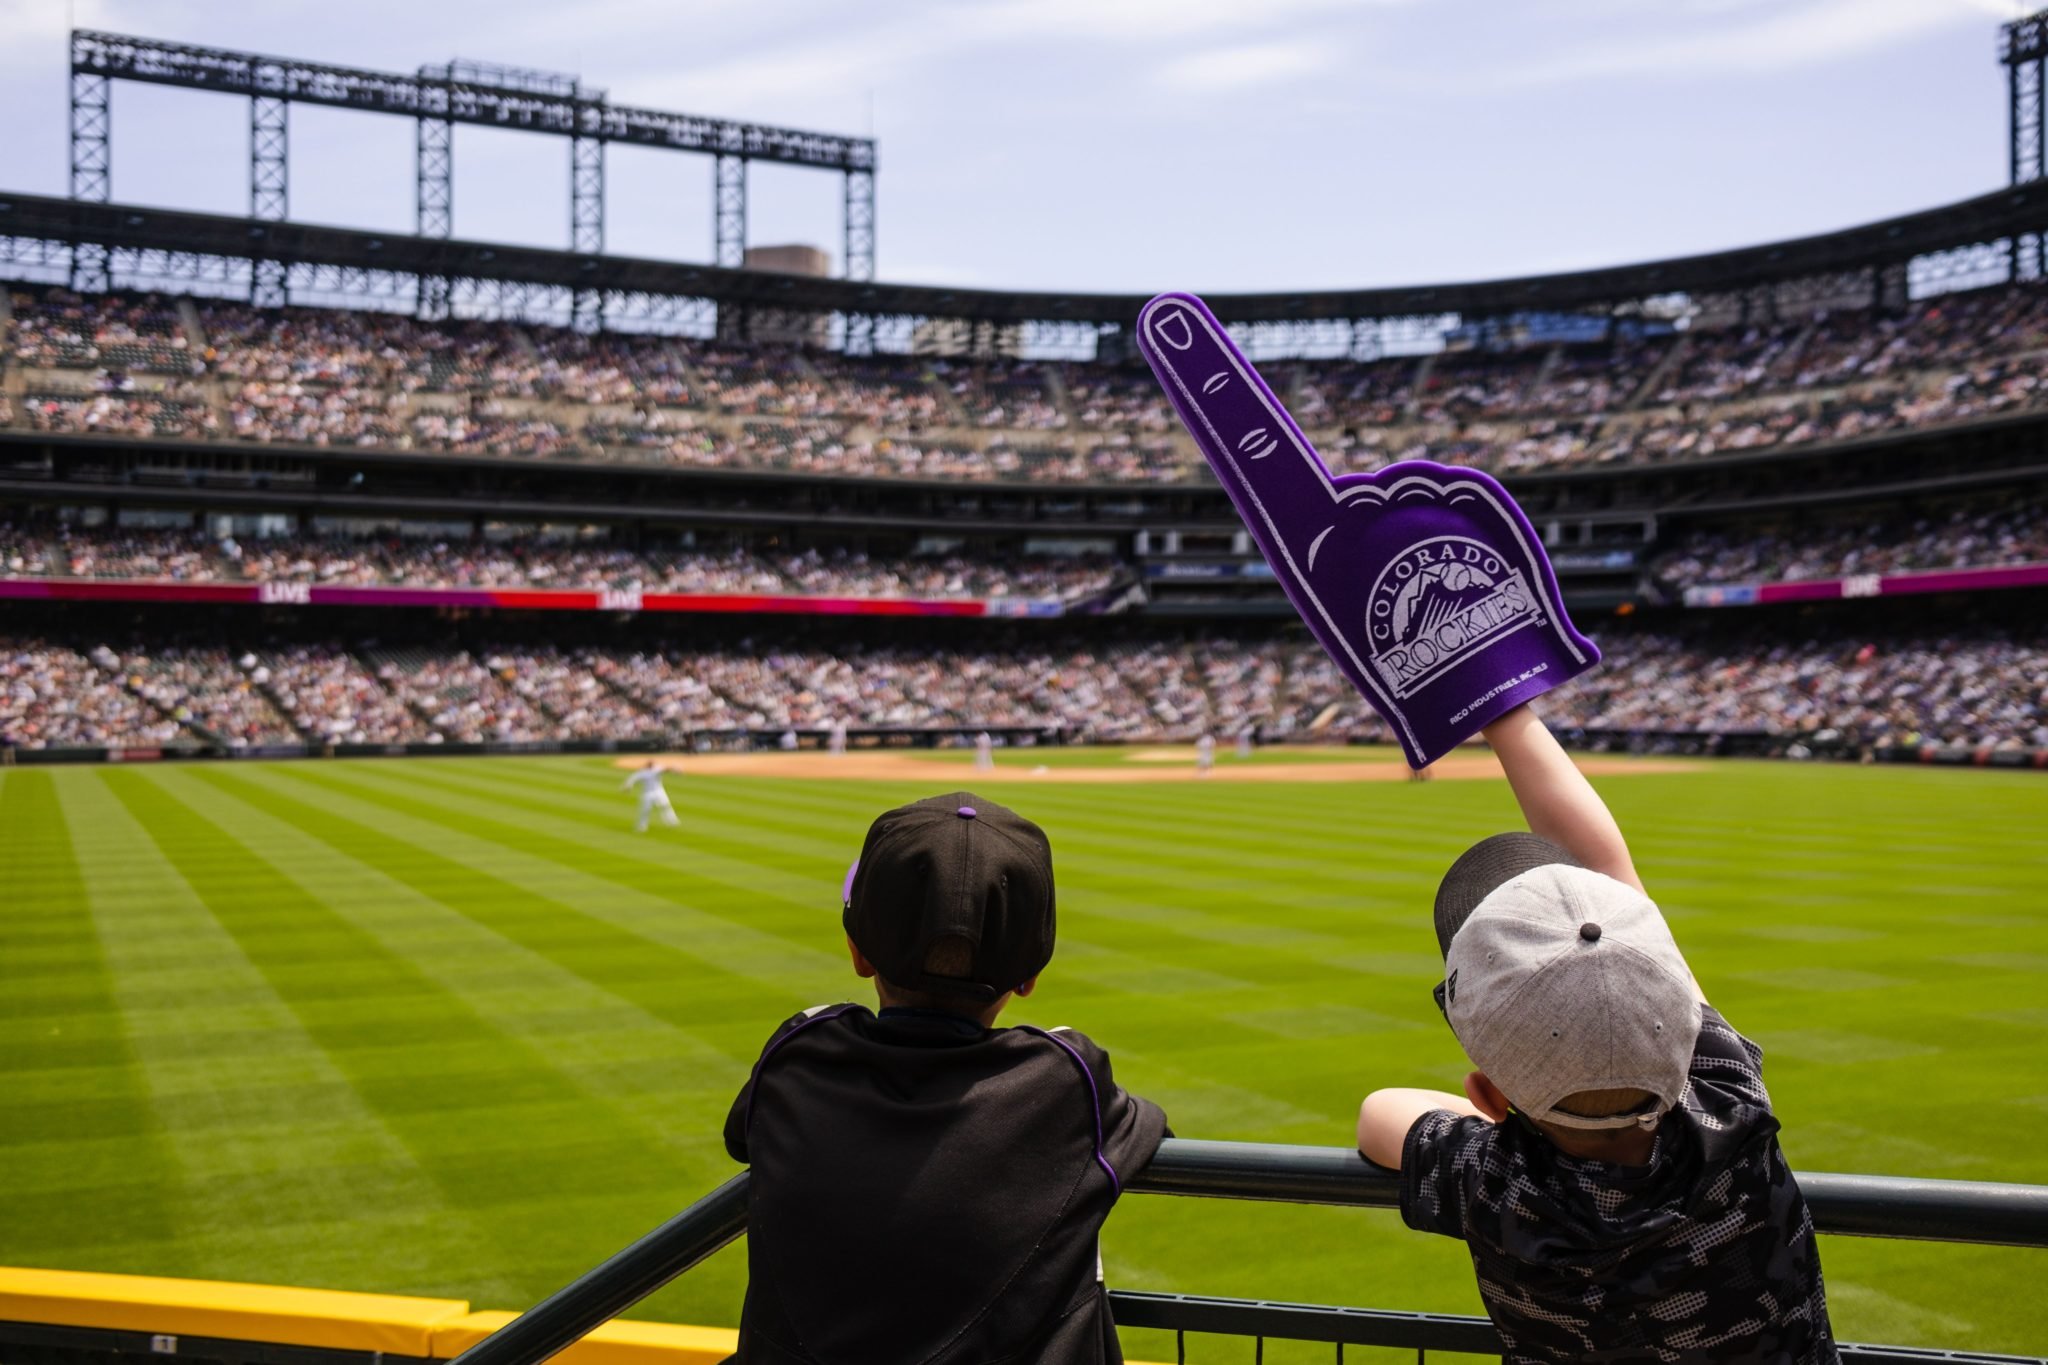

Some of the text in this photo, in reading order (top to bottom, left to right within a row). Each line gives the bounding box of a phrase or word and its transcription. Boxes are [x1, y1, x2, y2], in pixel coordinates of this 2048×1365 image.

[1374, 543, 1500, 641] COLORADO
[1381, 581, 1529, 687] ROCKIES
[1449, 708, 1469, 725] RICO
